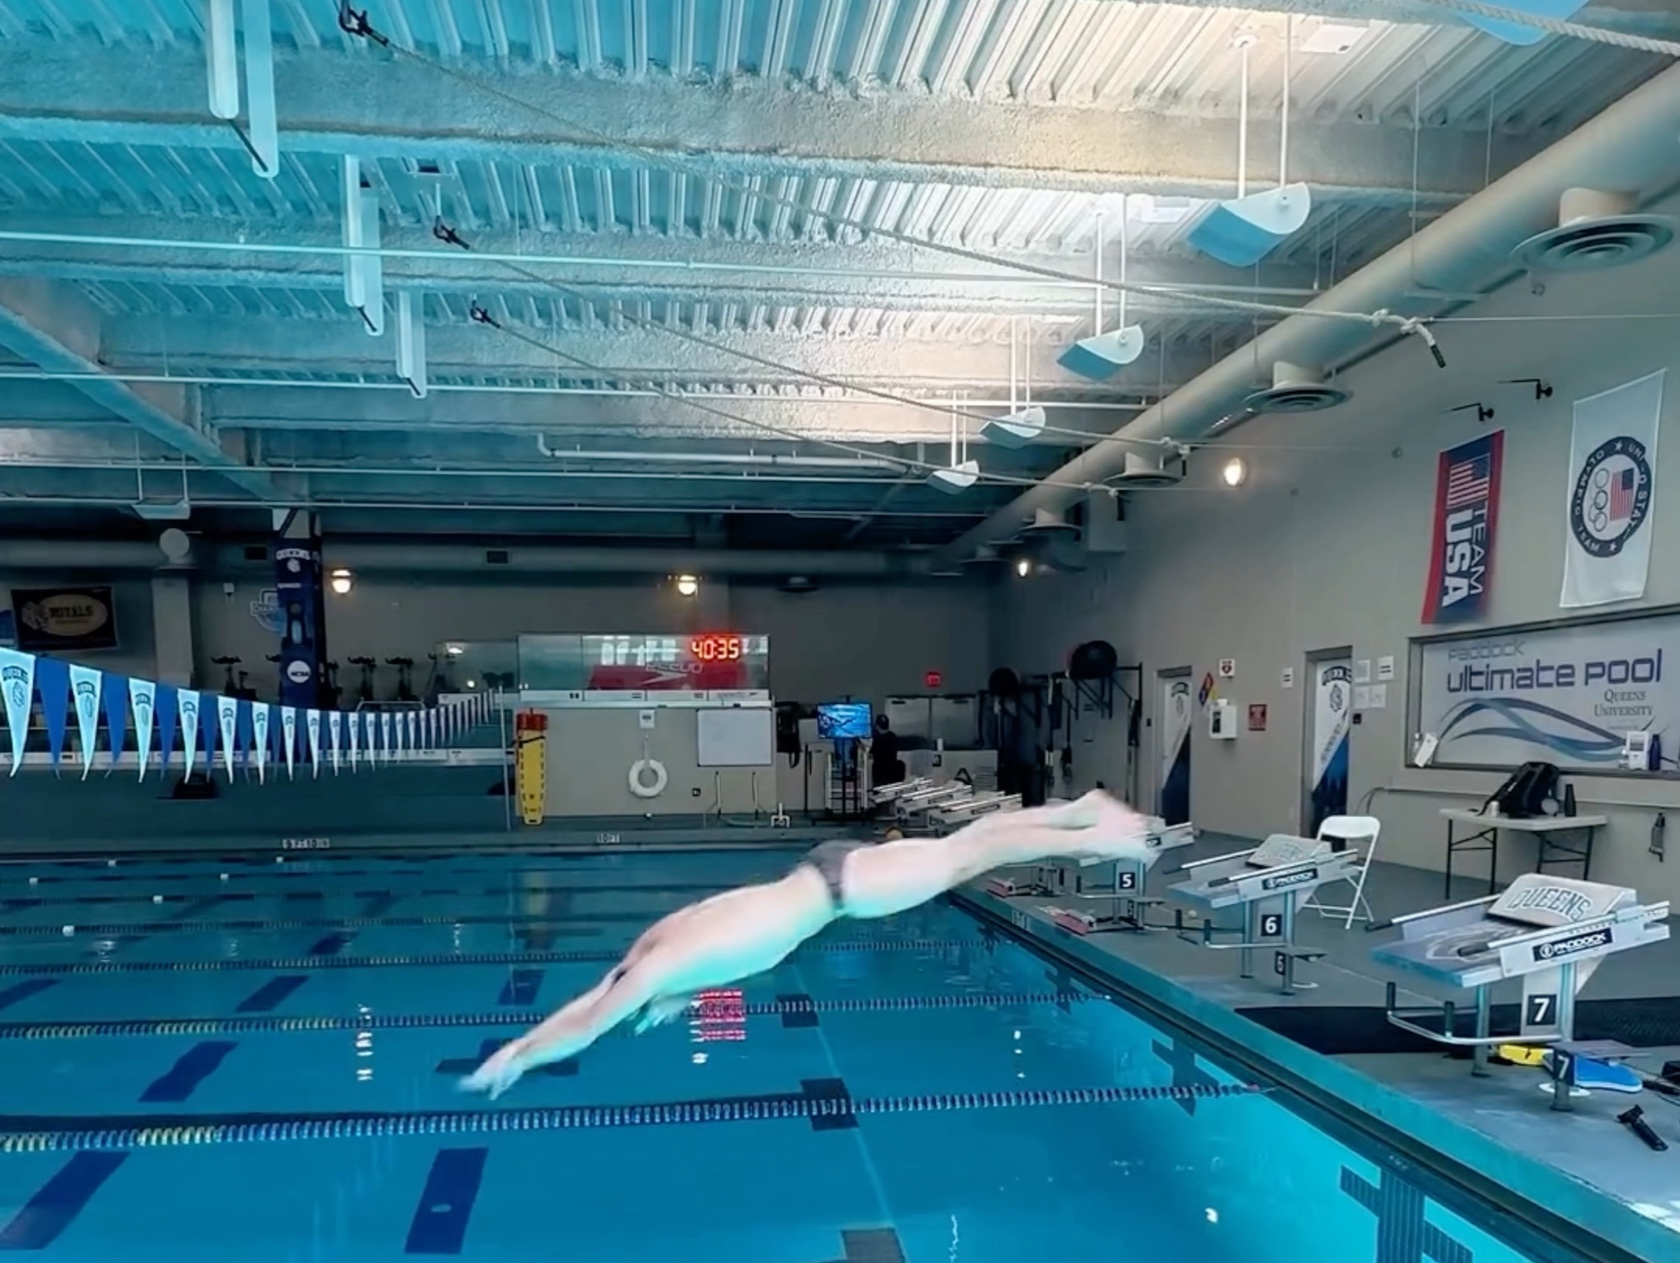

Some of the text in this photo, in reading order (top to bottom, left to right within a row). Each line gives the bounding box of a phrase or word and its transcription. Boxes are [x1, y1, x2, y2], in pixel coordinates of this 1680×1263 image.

[1470, 500, 1489, 594] TEAM
[1441, 510, 1473, 607] USA
[691, 638, 740, 660] 40:35
[1603, 688, 1647, 704] QUEENS
[1594, 704, 1654, 717] UNIVERSITY
[1122, 874, 1132, 888] 5
[1507, 885, 1592, 924] QUEENS
[1265, 917, 1277, 934] 6
[1554, 932, 1607, 955] PADDOCK
[1276, 955, 1285, 973] 6
[1533, 997, 1551, 1023] 7
[1556, 1054, 1571, 1080] 7
